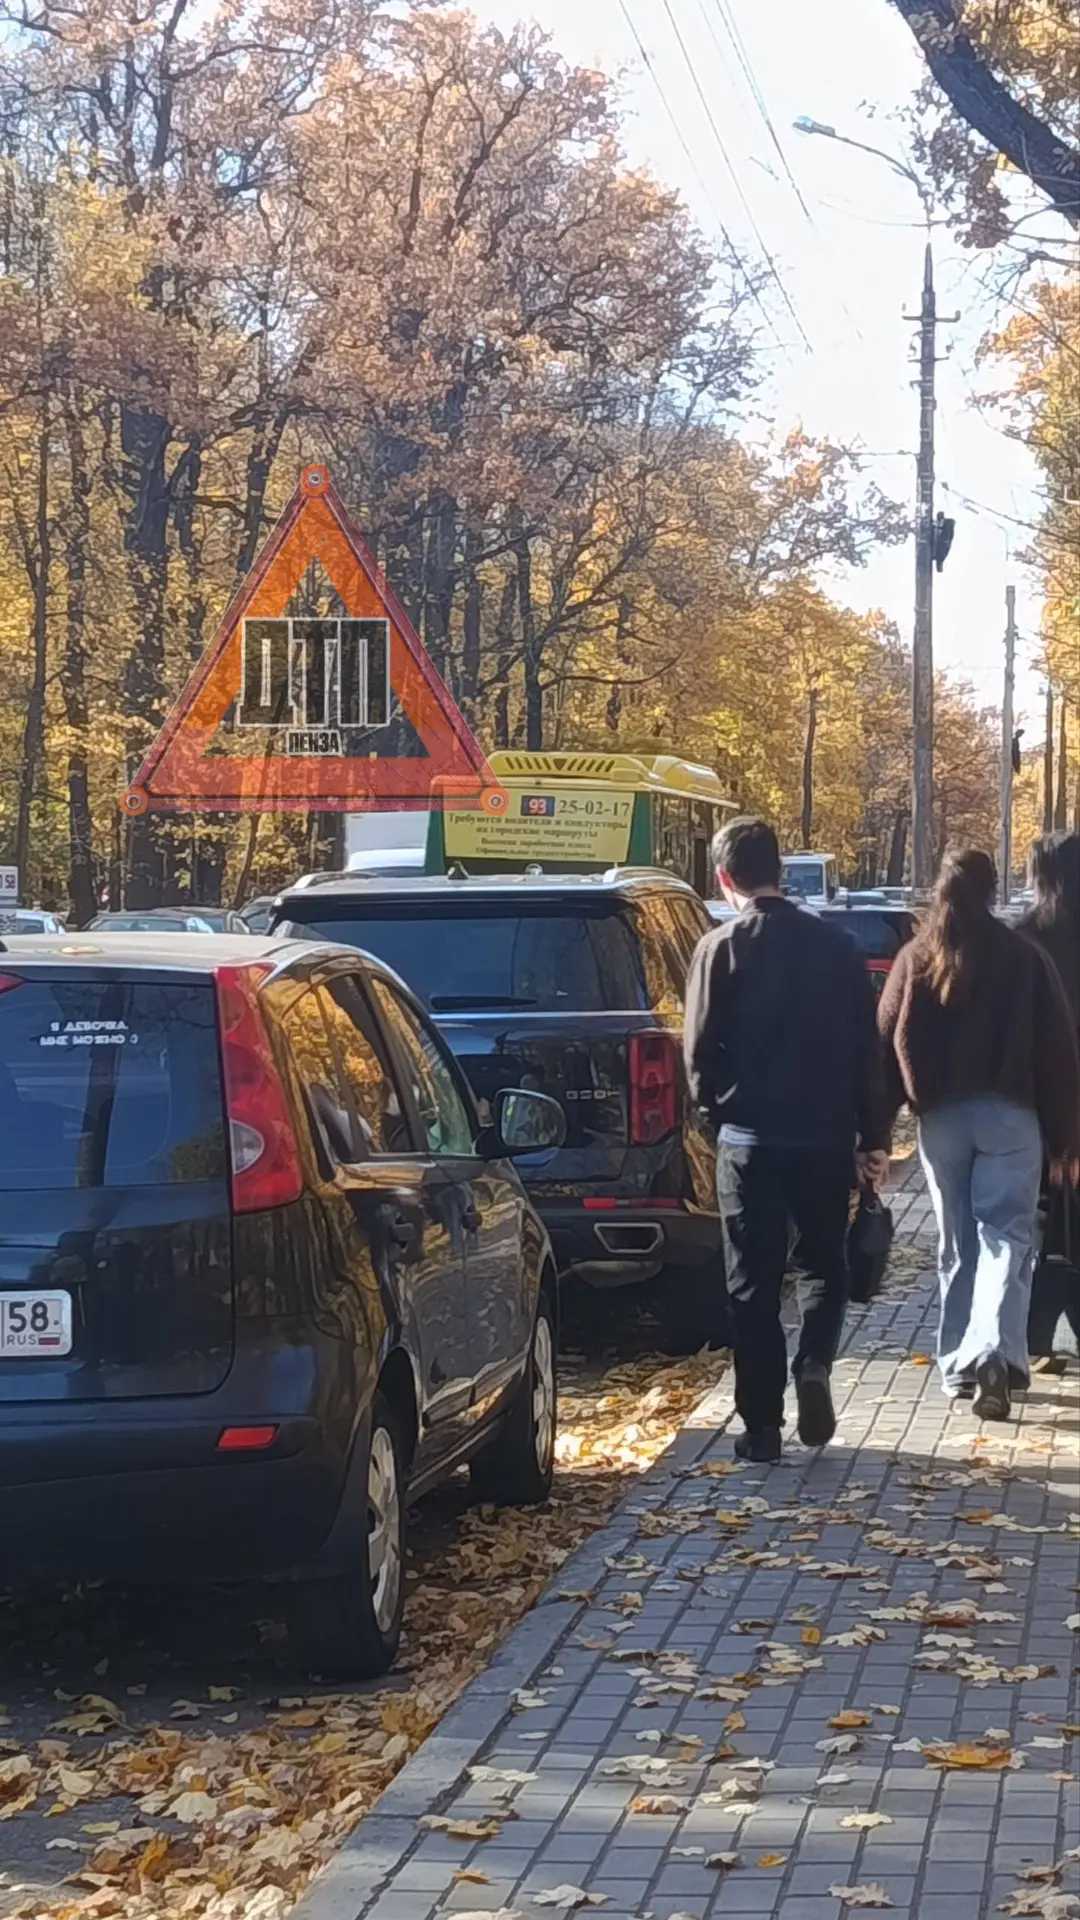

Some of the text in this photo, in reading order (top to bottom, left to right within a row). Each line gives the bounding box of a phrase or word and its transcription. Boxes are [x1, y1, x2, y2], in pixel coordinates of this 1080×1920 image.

[528, 799, 547, 815] 93
[558, 799, 630, 818] 25-02-17
[449, 813, 502, 826] Требуются
[9, 1301, 49, 1333] 58
[6, 1334, 37, 1346] RUS
